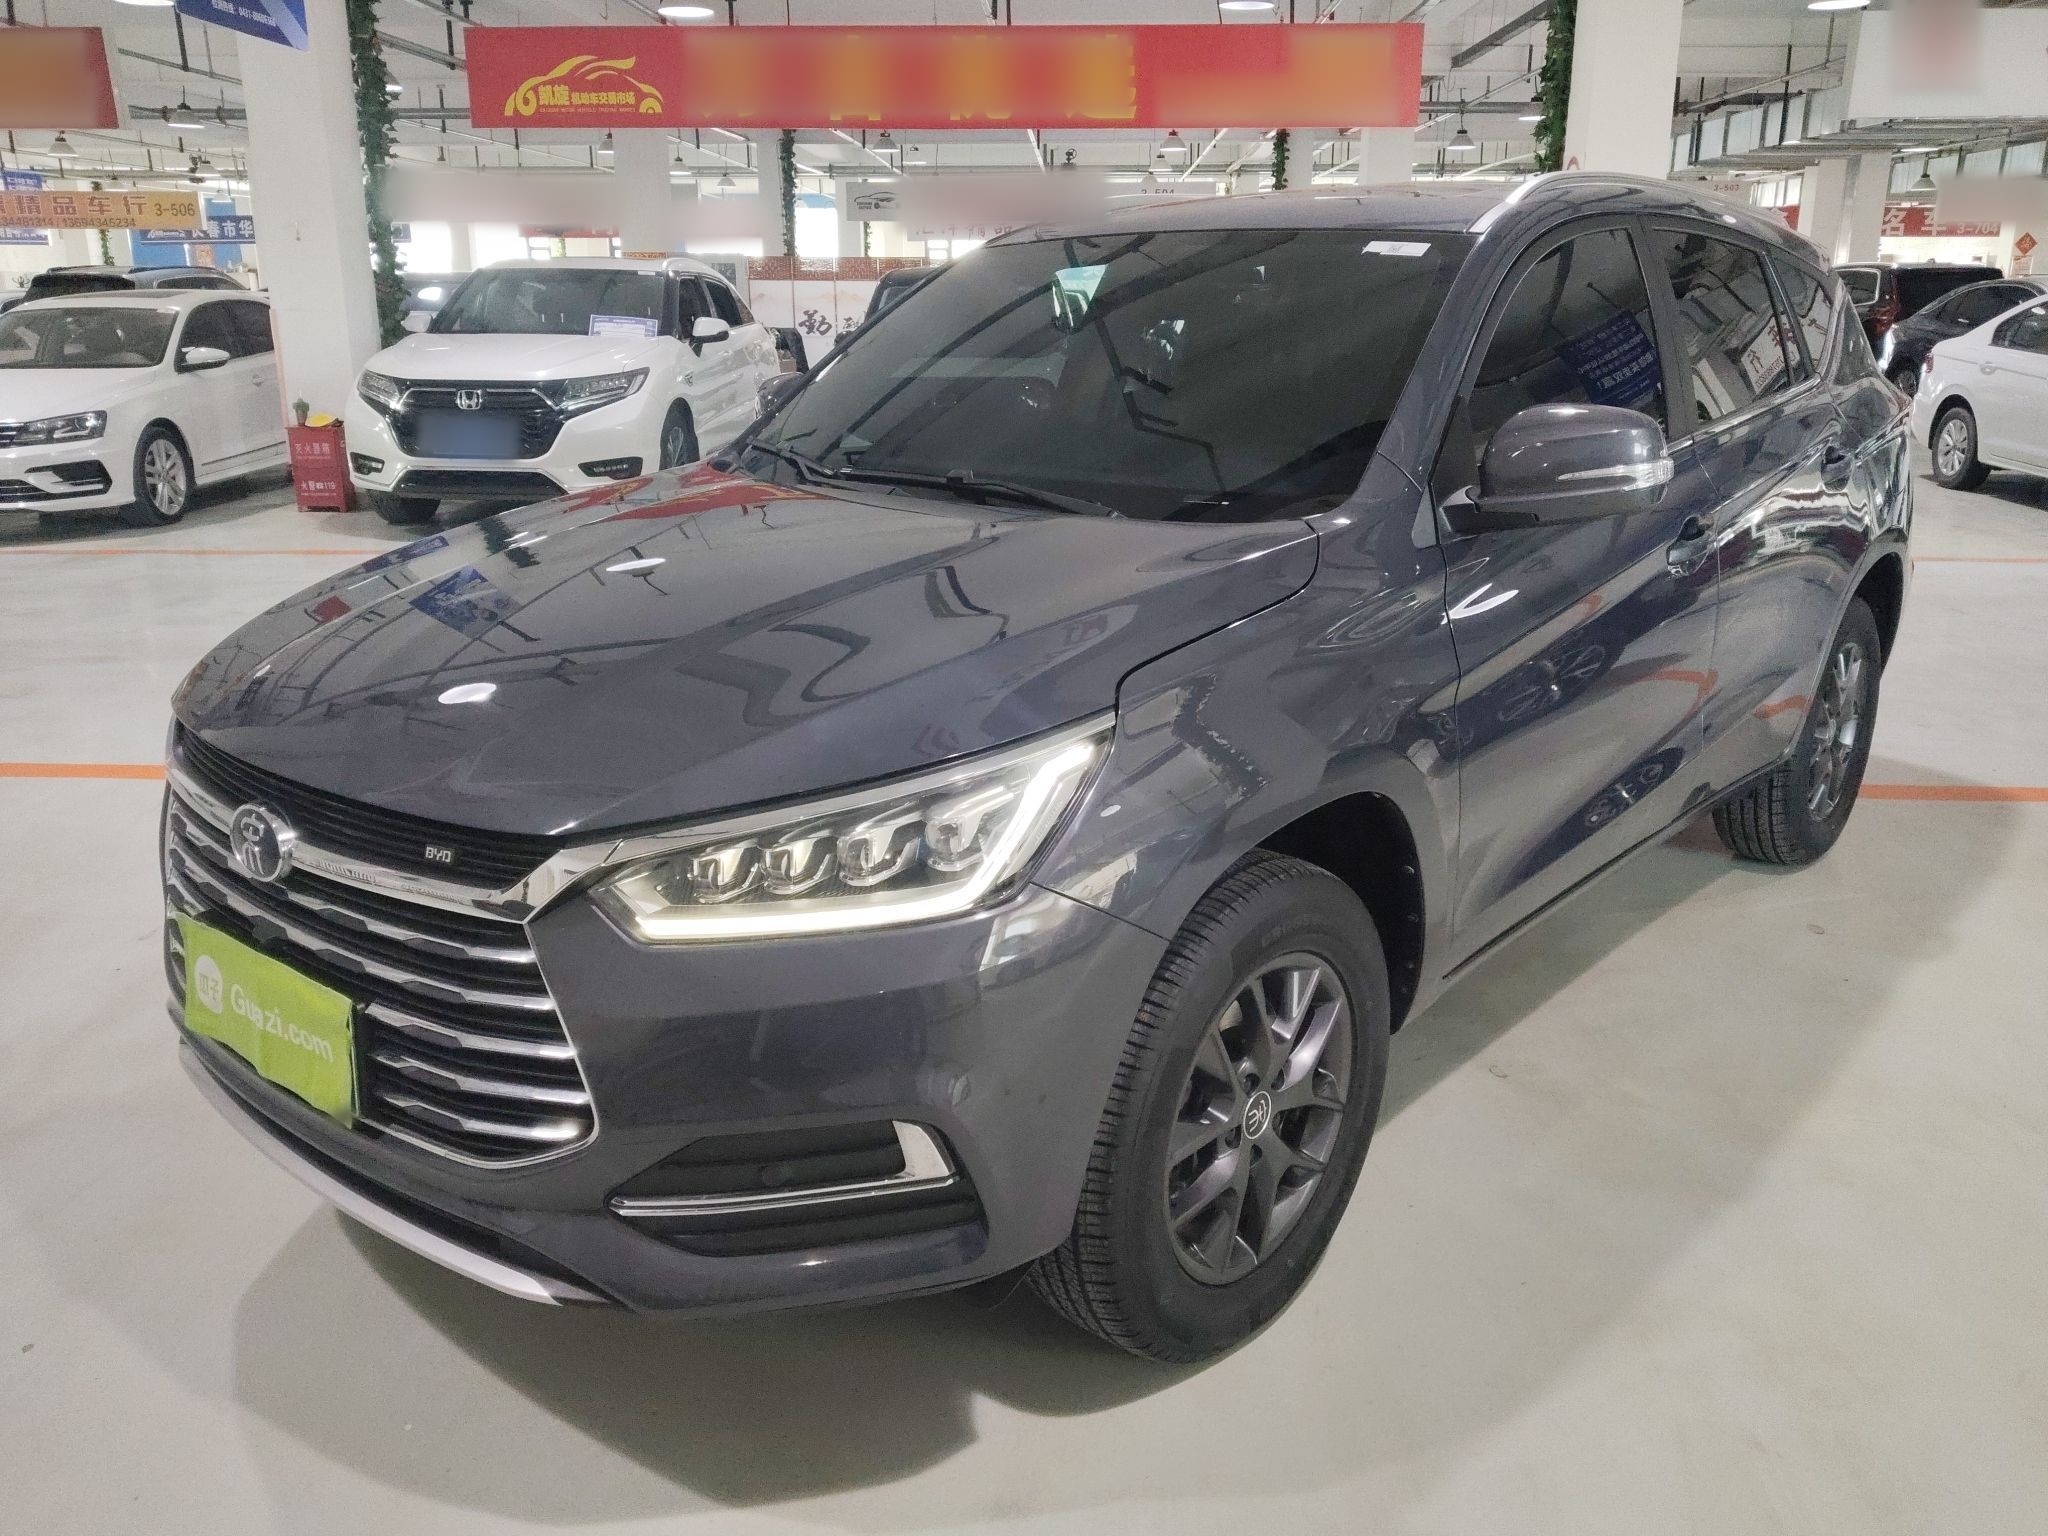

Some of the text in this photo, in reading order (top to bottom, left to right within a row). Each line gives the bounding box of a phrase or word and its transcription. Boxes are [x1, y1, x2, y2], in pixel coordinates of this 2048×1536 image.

[154, 203, 195, 216] 3-506
[1956, 219, 2000, 235] 3-704
[425, 846, 452, 863] BYD
[229, 983, 335, 1063] Guazi.com
